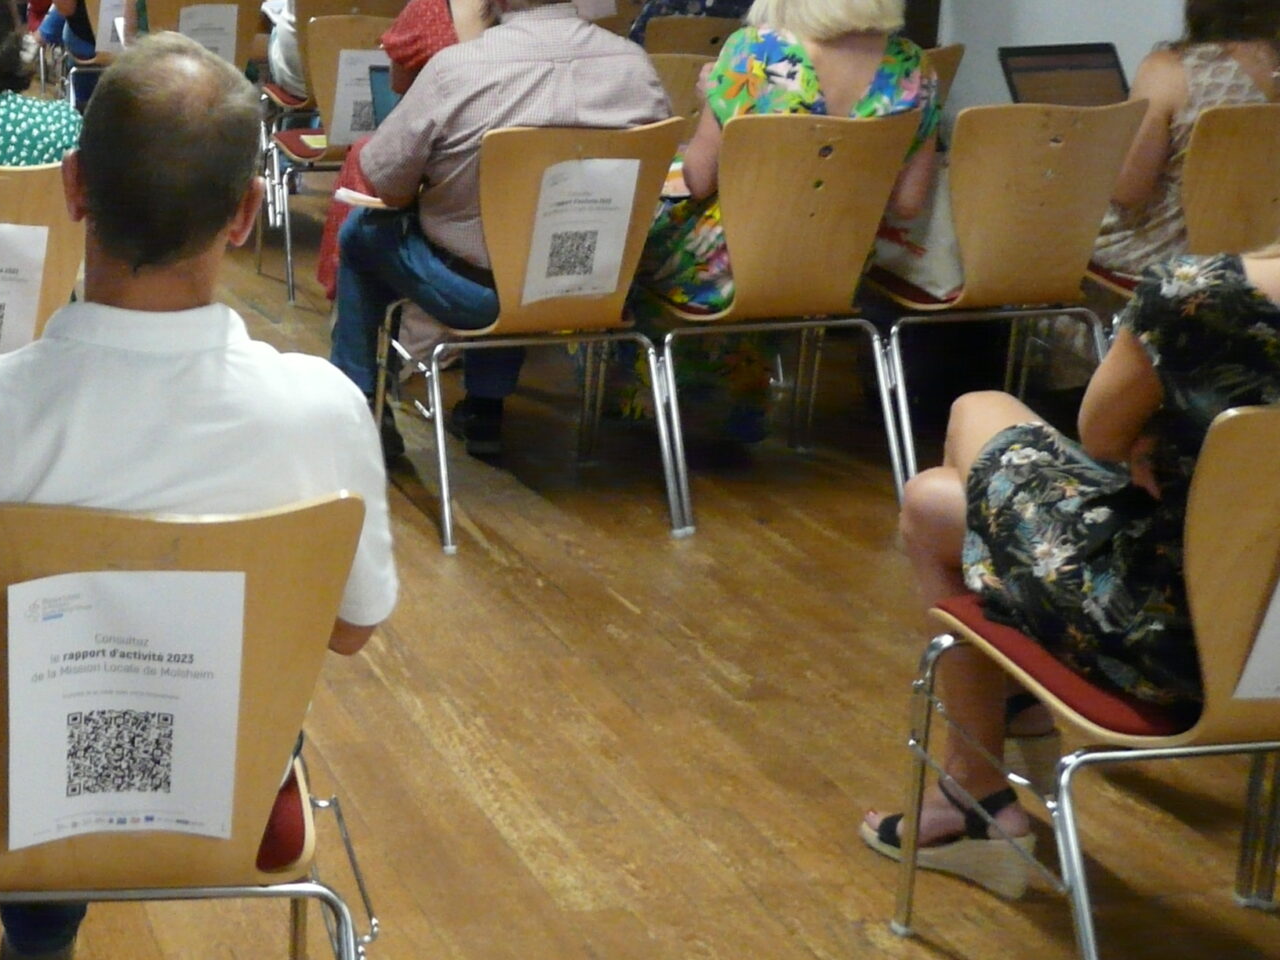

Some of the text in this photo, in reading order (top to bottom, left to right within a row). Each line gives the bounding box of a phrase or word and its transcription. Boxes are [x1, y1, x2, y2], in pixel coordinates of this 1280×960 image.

[94, 633, 150, 648] Consultez
[62, 648, 106, 663] rapport
[166, 653, 195, 664] 2023
[31, 662, 215, 683] de la Mission Locale de Molsheim
